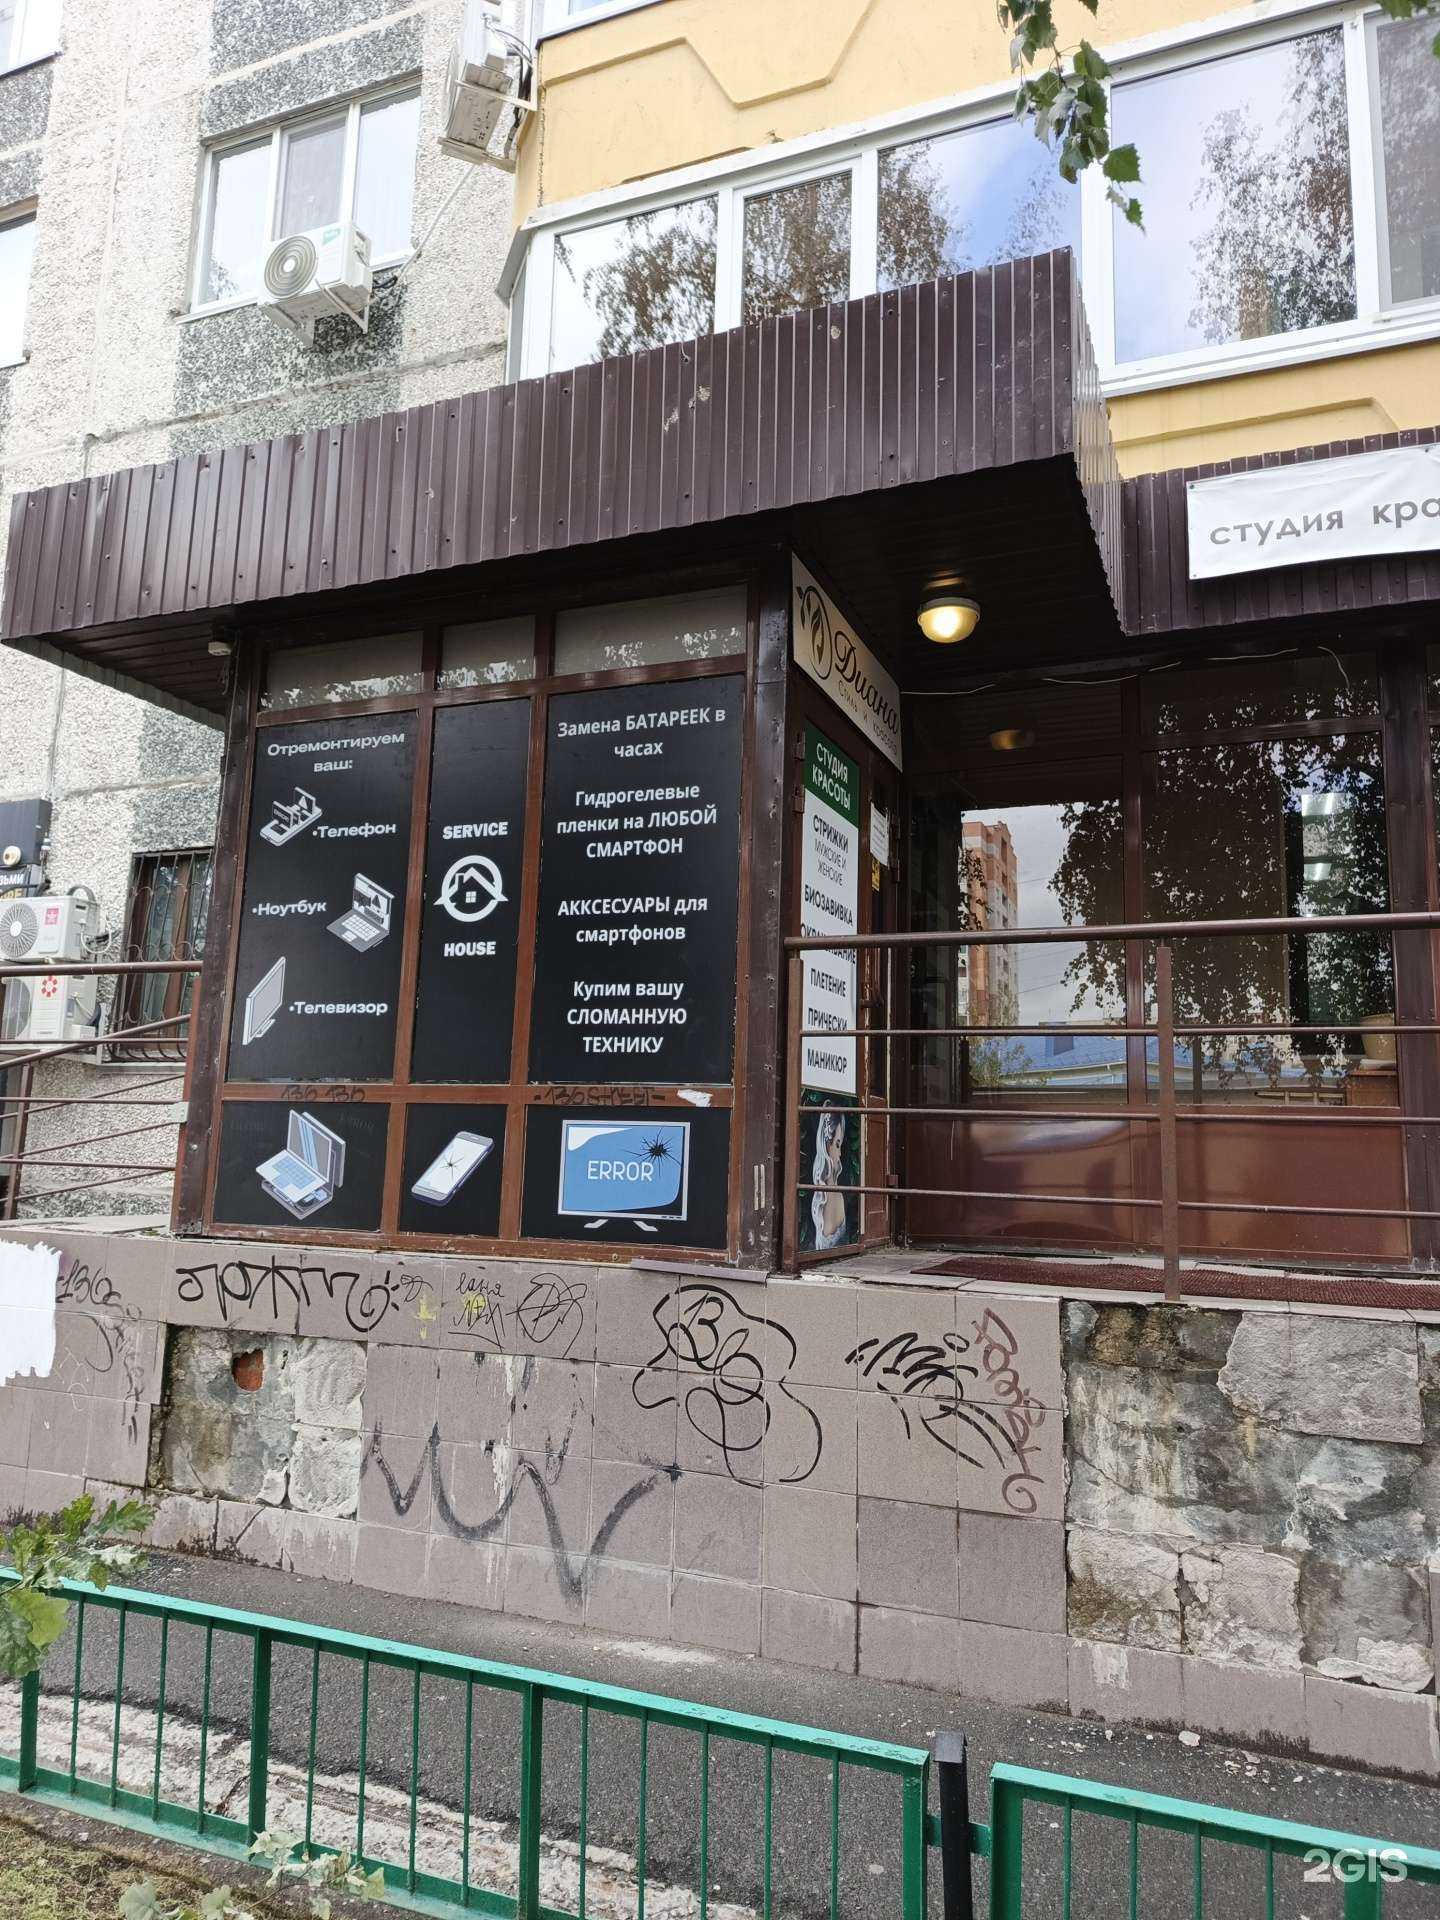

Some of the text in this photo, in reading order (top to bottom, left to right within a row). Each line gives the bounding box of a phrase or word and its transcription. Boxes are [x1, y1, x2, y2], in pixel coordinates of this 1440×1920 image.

[1209, 509, 1344, 547] студия
[834, 630, 899, 735] Диана
[557, 707, 726, 738] Замена БАТАРЕЕК в
[267, 731, 405, 758] Отремонтируем
[614, 740, 664, 759] часах
[313, 757, 353, 773] ваш:
[816, 743, 849, 783] СТУДИЯ
[575, 783, 700, 808] Гидрогелевые
[812, 765, 851, 811] КРАСОТЫ
[442, 820, 510, 840] SERVICE
[556, 803, 718, 834] пленки на ЛЮБОЙ
[813, 814, 849, 853] СТРИЖКИ
[586, 837, 683, 858] СМАРТФОН
[557, 896, 708, 917] АККСЕСУАРЫ для
[804, 884, 853, 926] БИОЗАВИВКА
[576, 924, 686, 946] смартфонов
[443, 941, 497, 957] HOUSE
[573, 980, 684, 1002] Купим вашу
[810, 968, 847, 997] ПЛЕТЕНИЕ
[567, 1007, 687, 1025] СЛОМАННУЮ
[808, 1007, 848, 1031] ПРИЧЕСКИ
[582, 1035, 664, 1054] ТЕХНИКУ
[807, 1048, 848, 1074] МАНИКЮР
[587, 1160, 655, 1183] ERROR
